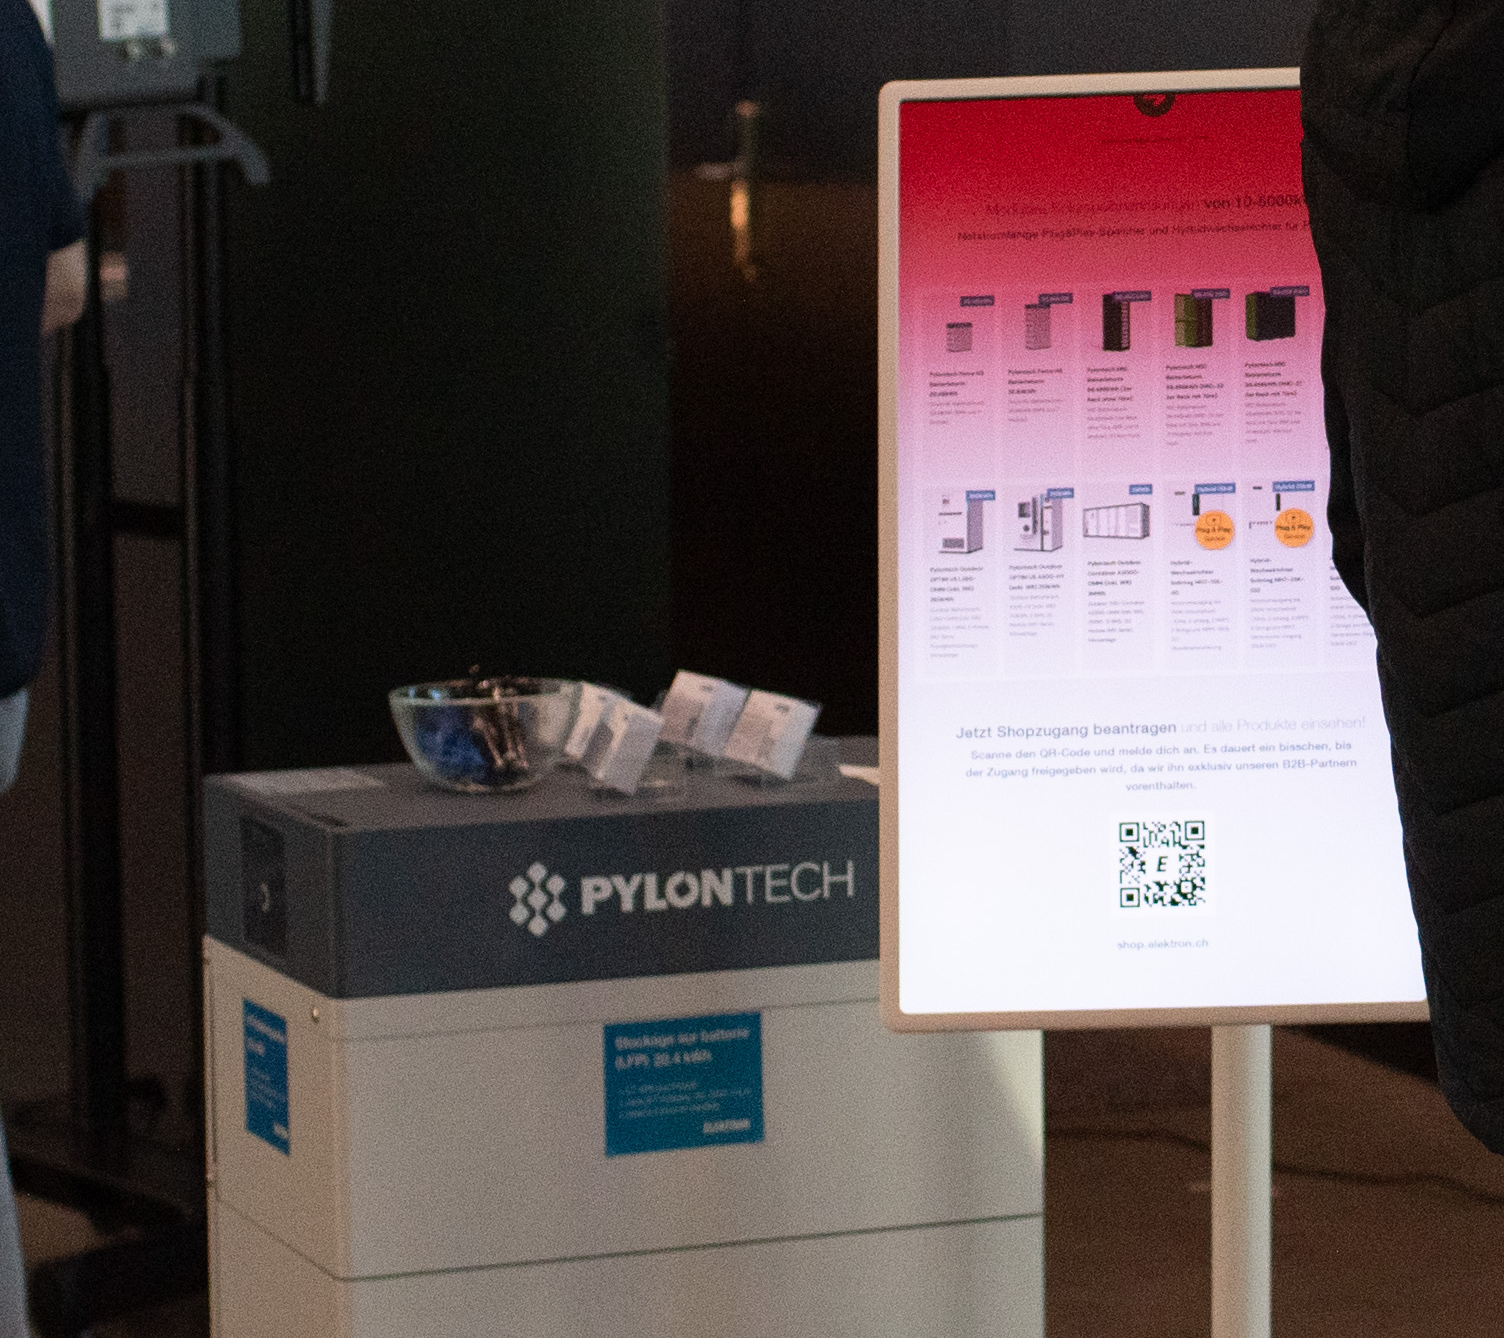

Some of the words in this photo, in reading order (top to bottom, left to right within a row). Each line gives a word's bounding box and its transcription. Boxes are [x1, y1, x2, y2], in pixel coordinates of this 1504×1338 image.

[956, 726, 993, 739] Jetzt
[997, 725, 1089, 740] Shopzugang
[1093, 721, 1177, 738] beantragen
[1181, 721, 1207, 733] und
[1211, 720, 1233, 732] alle
[1237, 718, 1297, 731] Produkte
[970, 750, 1012, 760] Scanne
[1015, 749, 1036, 759] den
[1039, 747, 1091, 759] QR-Code
[1094, 747, 1115, 757] und
[1119, 746, 1153, 756] melde
[1156, 745, 1179, 755] dich
[1203, 744, 1217, 754] Es
[1220, 743, 1256, 753] dauert
[1259, 743, 1276, 752] ein
[1335, 741, 1353, 751] bis
[965, 768, 983, 778] der
[986, 767, 1028, 779] Zugang
[1032, 765, 1097, 778] freigegeben
[1130, 764, 1145, 774] da
[1147, 764, 1164, 773] wir
[1167, 763, 1184, 772] ihn
[1187, 762, 1232, 772] exklusiv
[1235, 761, 1279, 770] unseren
[580, 859, 855, 915] PYLONTECH
